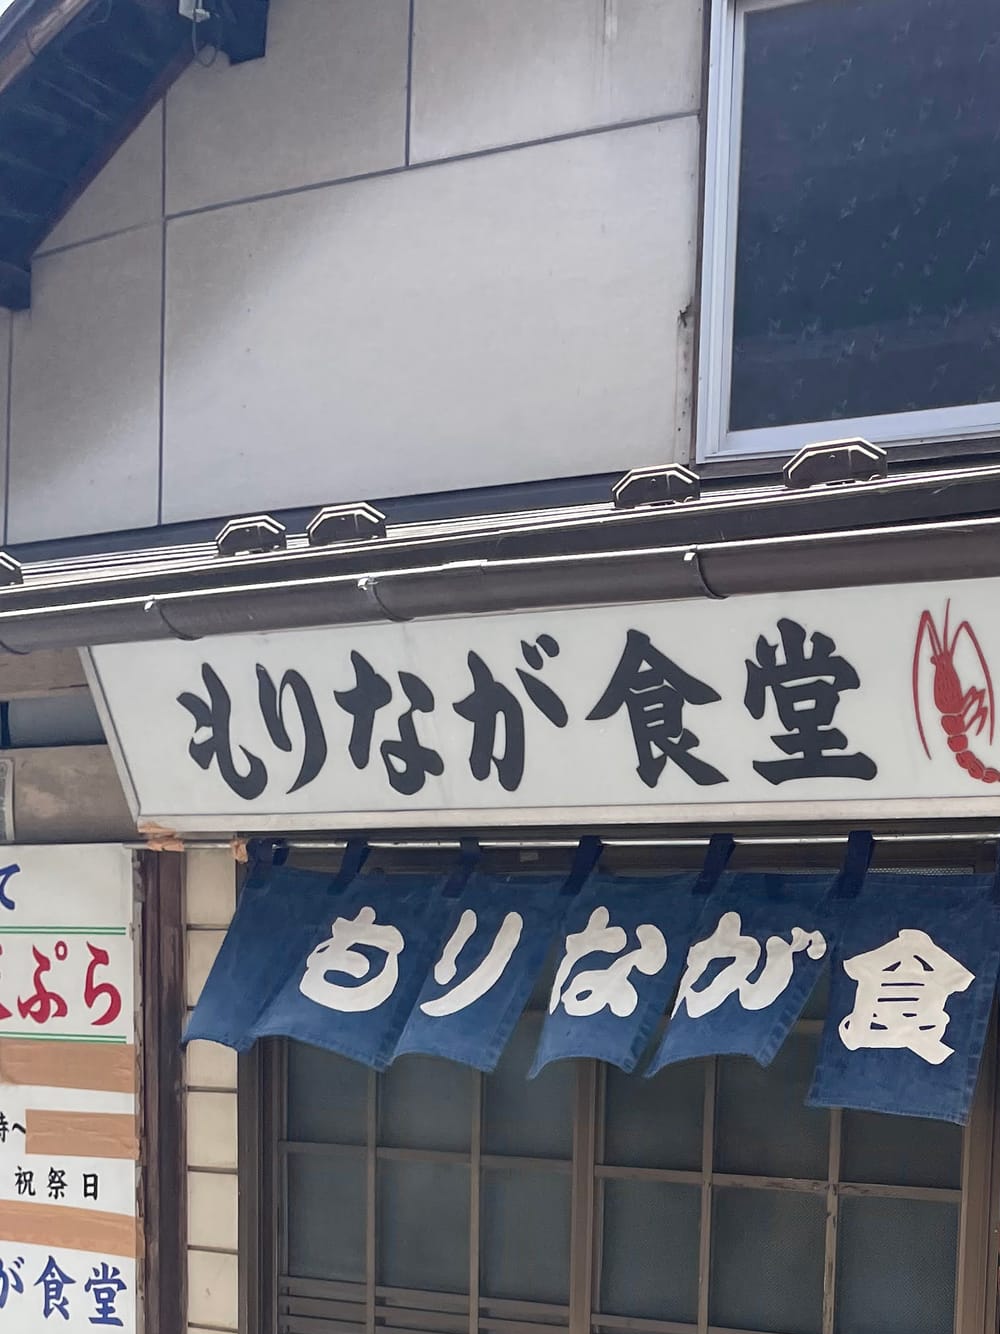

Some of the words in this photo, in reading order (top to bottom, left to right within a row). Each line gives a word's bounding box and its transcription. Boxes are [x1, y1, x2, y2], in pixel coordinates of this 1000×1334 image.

[177, 617, 878, 800] もりなが食堂
[0, 940, 122, 1026] ぷら
